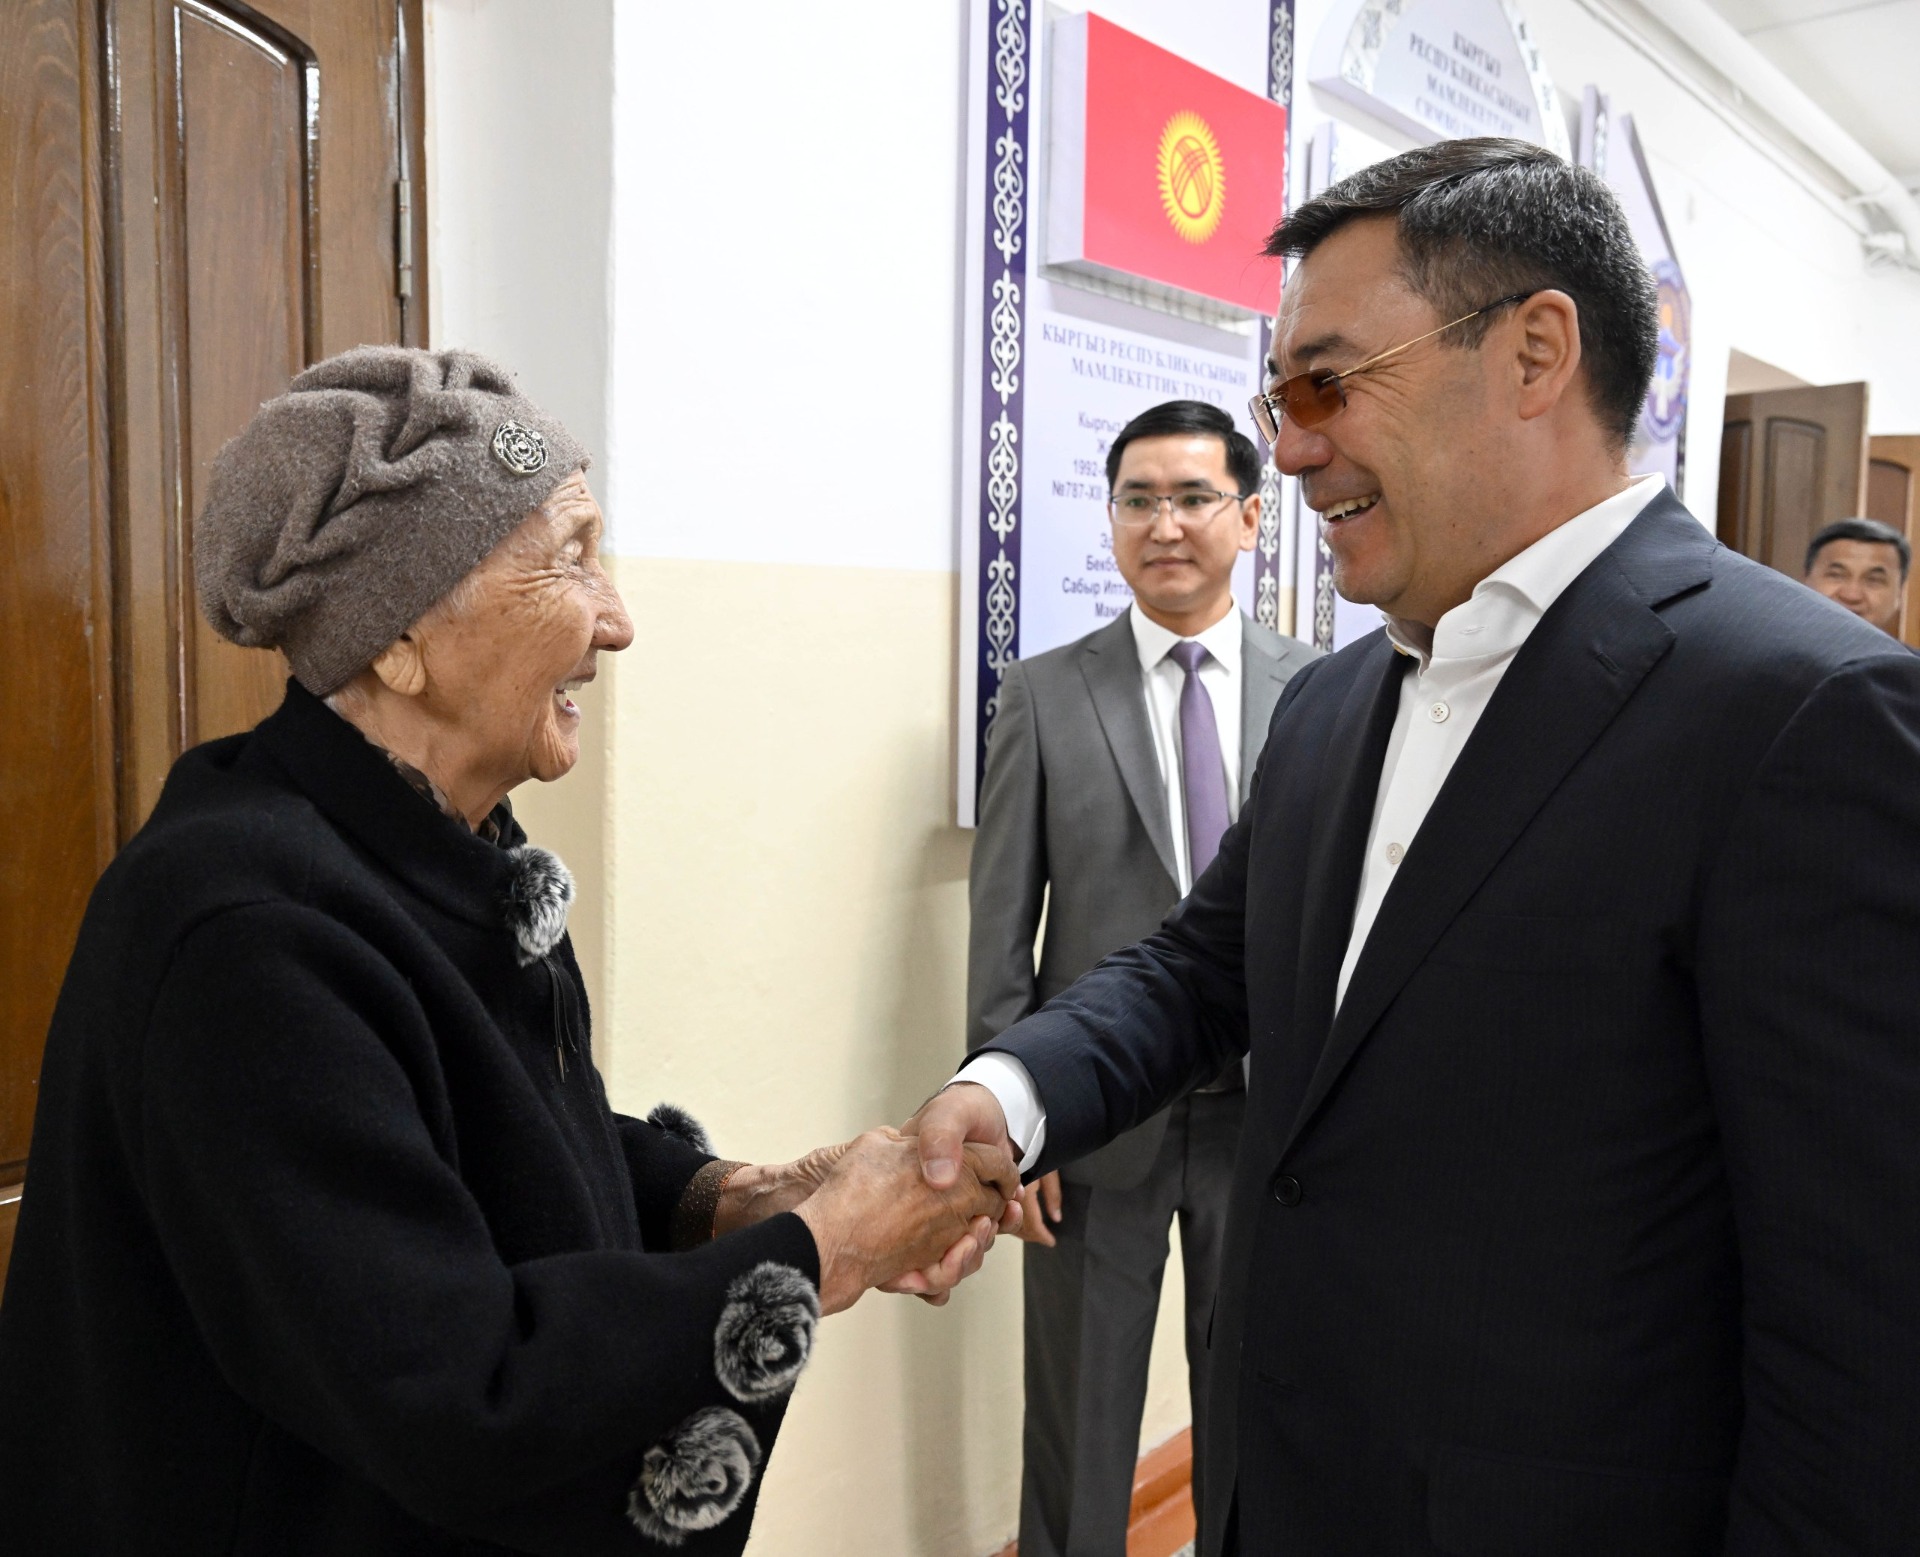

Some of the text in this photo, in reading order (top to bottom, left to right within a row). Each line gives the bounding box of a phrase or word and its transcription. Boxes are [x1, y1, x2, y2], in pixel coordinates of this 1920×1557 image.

[1042, 323, 1248, 387] КЫРГЫЗ РЕСПУБЛИКАСЫНЫН
[1071, 357, 1180, 396] МАМЛЕКЕТТИК
[1062, 577, 1101, 597] Сабыр
